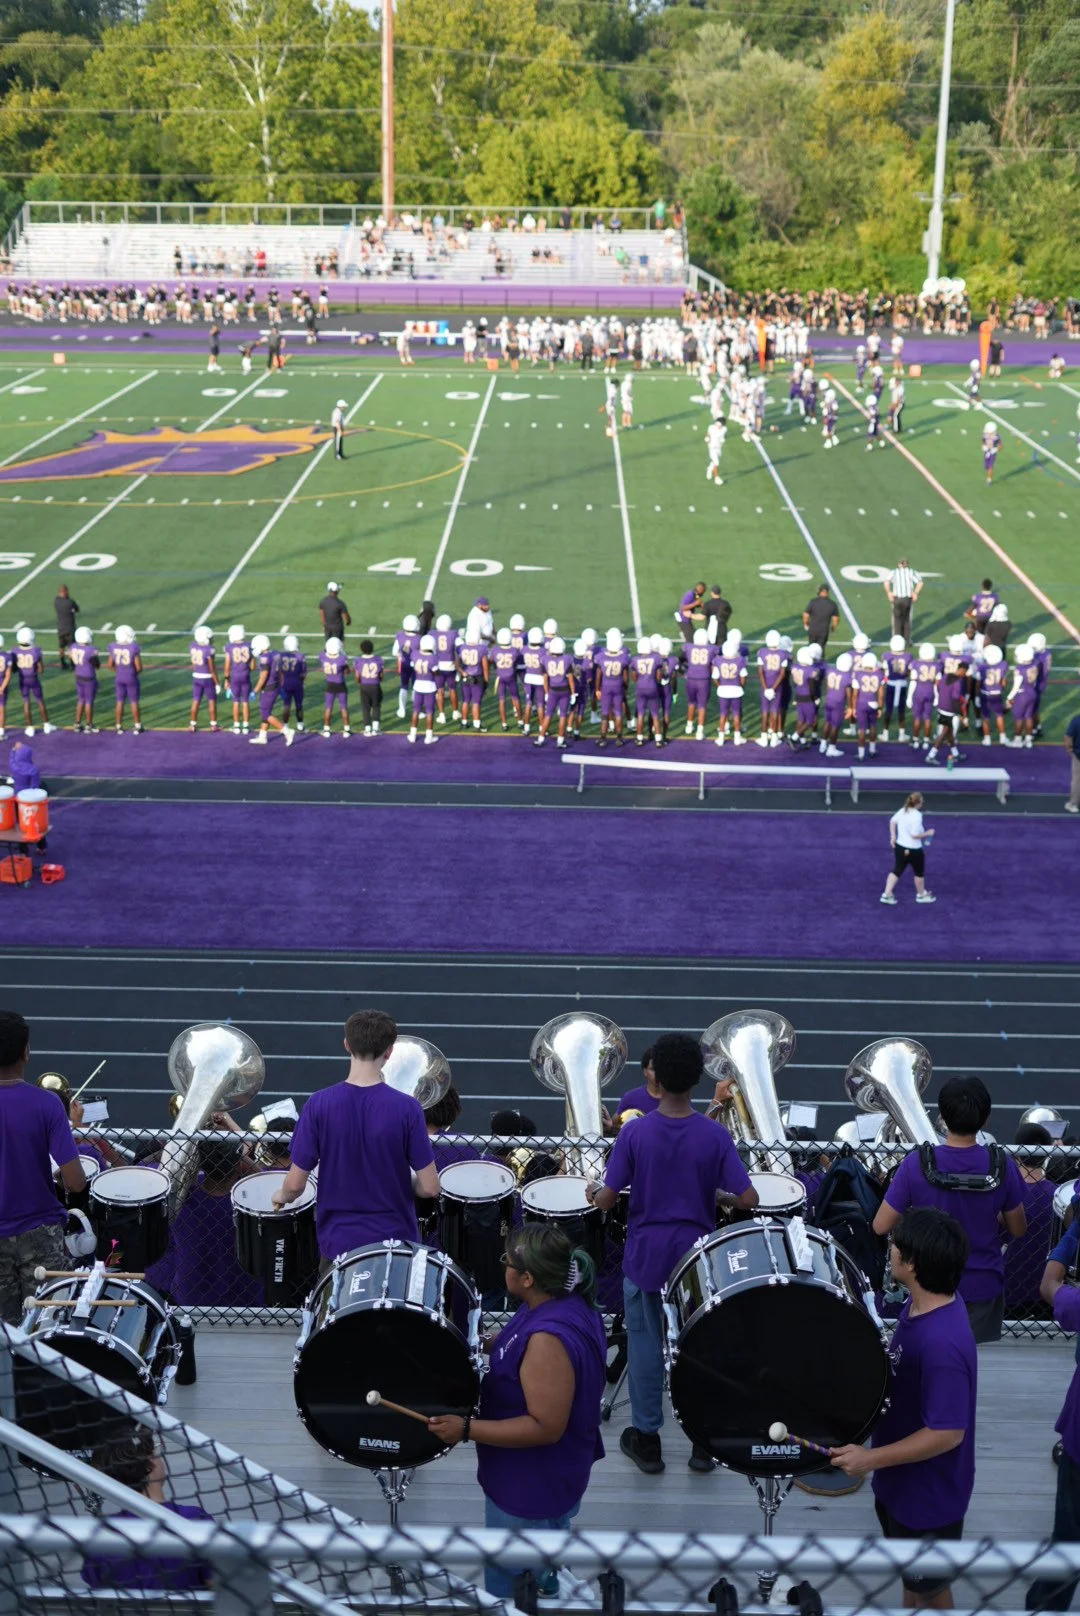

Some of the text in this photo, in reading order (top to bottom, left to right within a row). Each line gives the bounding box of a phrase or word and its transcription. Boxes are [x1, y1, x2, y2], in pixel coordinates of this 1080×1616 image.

[113, 647, 131, 666] 73
[495, 652, 514, 669] 25
[361, 661, 379, 679] 42
[603, 660, 622, 678] 79
[273, 1238, 285, 1283] VIC FIRTH
[359, 1437, 401, 1449] EVANS
[751, 1445, 801, 1455] EVANS
